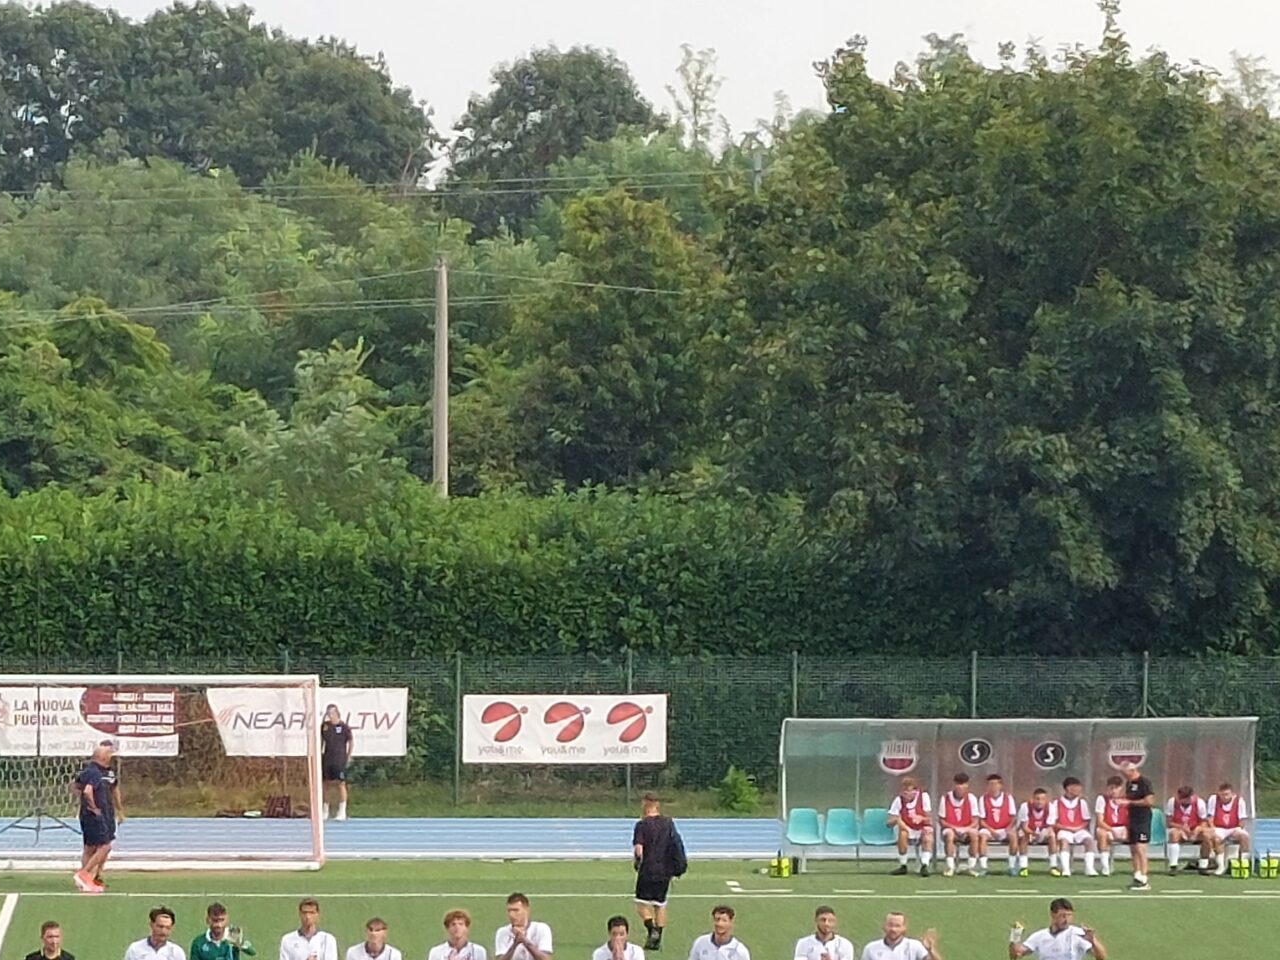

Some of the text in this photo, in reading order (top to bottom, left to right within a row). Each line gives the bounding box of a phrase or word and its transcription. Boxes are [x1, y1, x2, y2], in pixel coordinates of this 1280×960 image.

[14, 699, 75, 712] LA NUOVA
[14, 714, 59, 727] FUCNA
[232, 711, 401, 730] NEAR LTW
